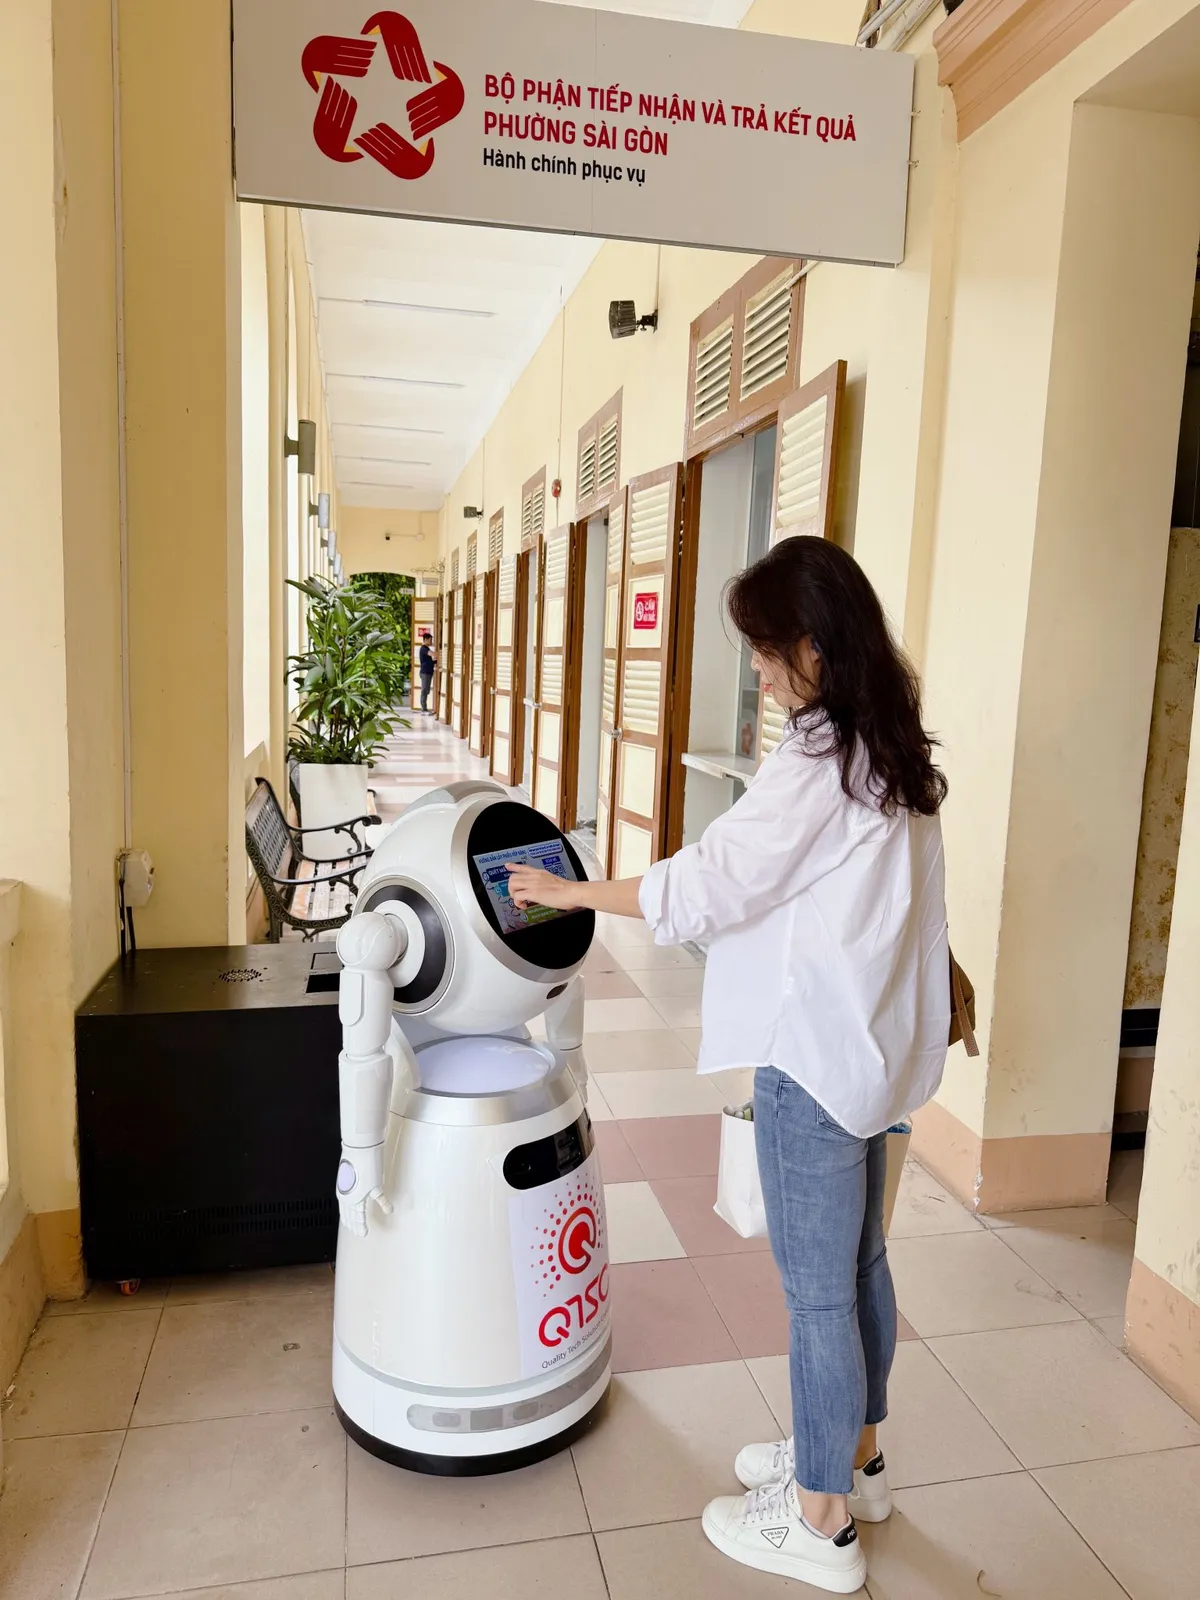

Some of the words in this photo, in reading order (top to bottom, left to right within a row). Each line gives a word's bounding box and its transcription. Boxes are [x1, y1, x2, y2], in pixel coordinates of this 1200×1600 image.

[484, 72, 515, 104] BỘ
[522, 78, 582, 110] PHẬN
[587, 84, 633, 113] TIẾP
[638, 93, 696, 125] NHẬN
[701, 100, 727, 126] VÀ
[731, 103, 769, 132] TRẢ
[773, 107, 812, 136] KẾT
[815, 113, 857, 143] QUẢ
[483, 110, 577, 145] PHƯỜNG
[583, 122, 617, 150] SÀI
[623, 127, 669, 156] GÒN
[482, 147, 526, 170] Hành
[531, 153, 577, 176] chính
[582, 159, 623, 184] phục
[626, 166, 646, 187] vụ
[541, 1351, 567, 1369] Quality
[567, 1340, 582, 1354] Tech
